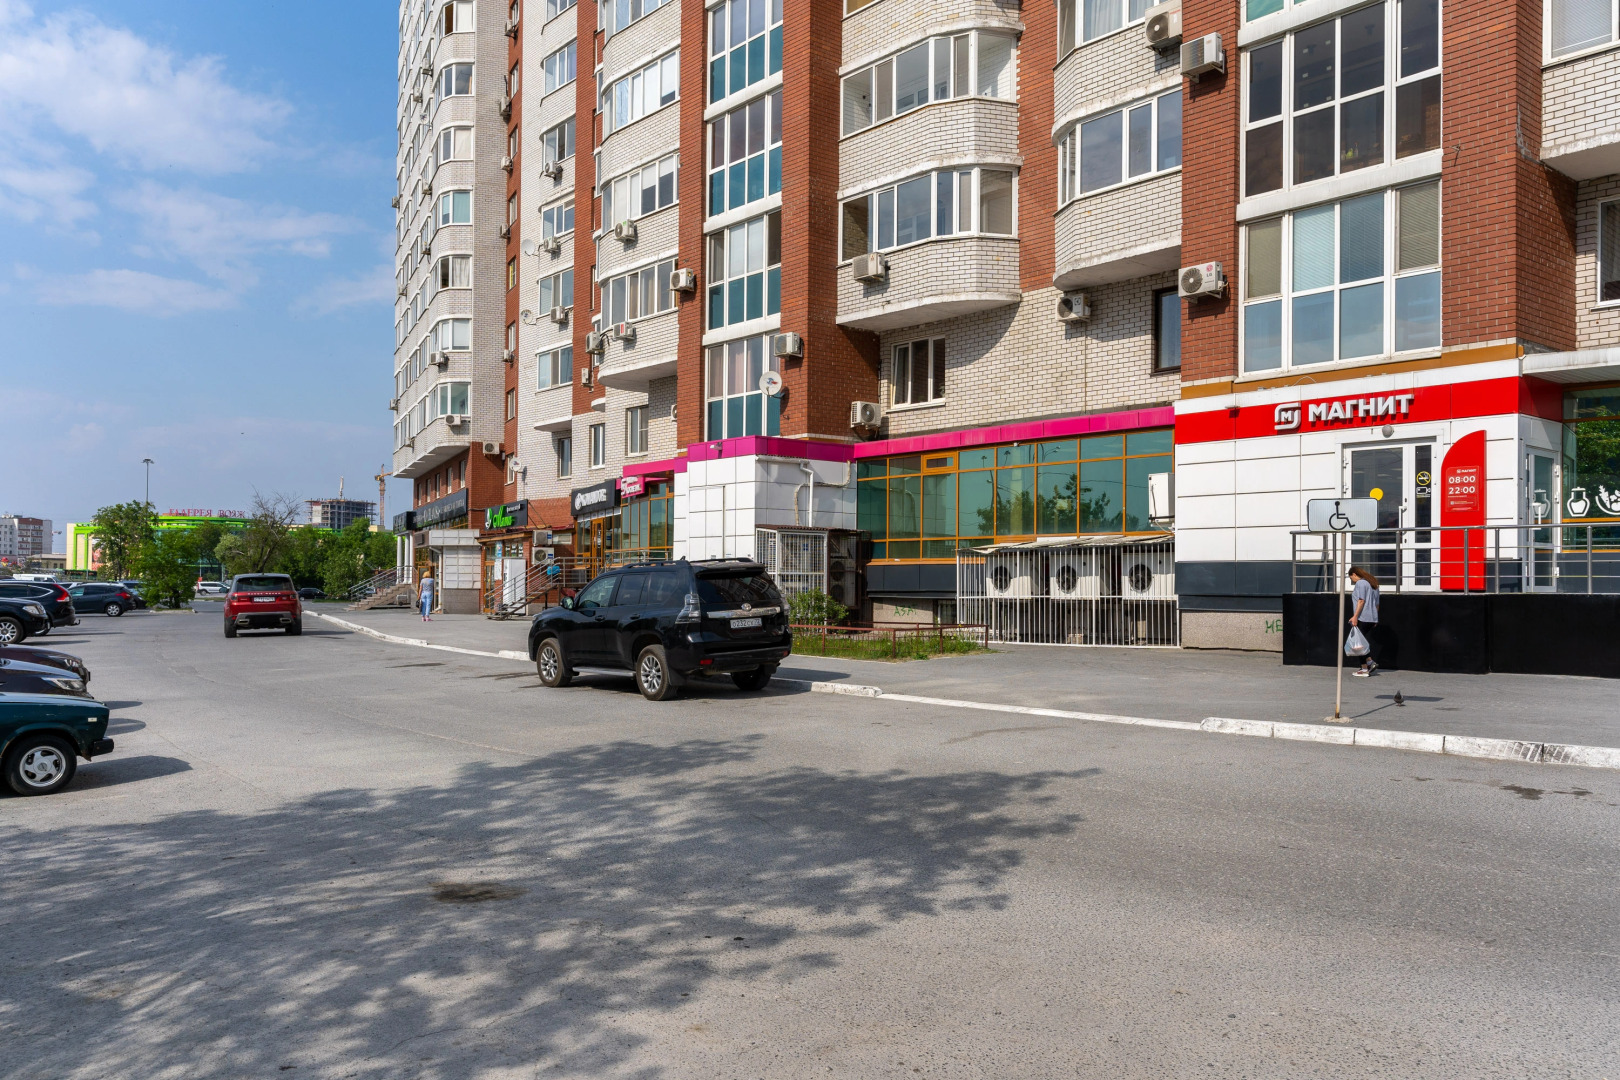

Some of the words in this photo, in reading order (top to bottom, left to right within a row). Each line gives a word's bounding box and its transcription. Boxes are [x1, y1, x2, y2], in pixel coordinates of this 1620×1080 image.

[1308, 394, 1414, 422] МАГНИТ
[1448, 475, 1476, 484] 08:00
[1448, 486, 1476, 494] 22:00
[218, 509, 246, 518] ВОЯЖ
